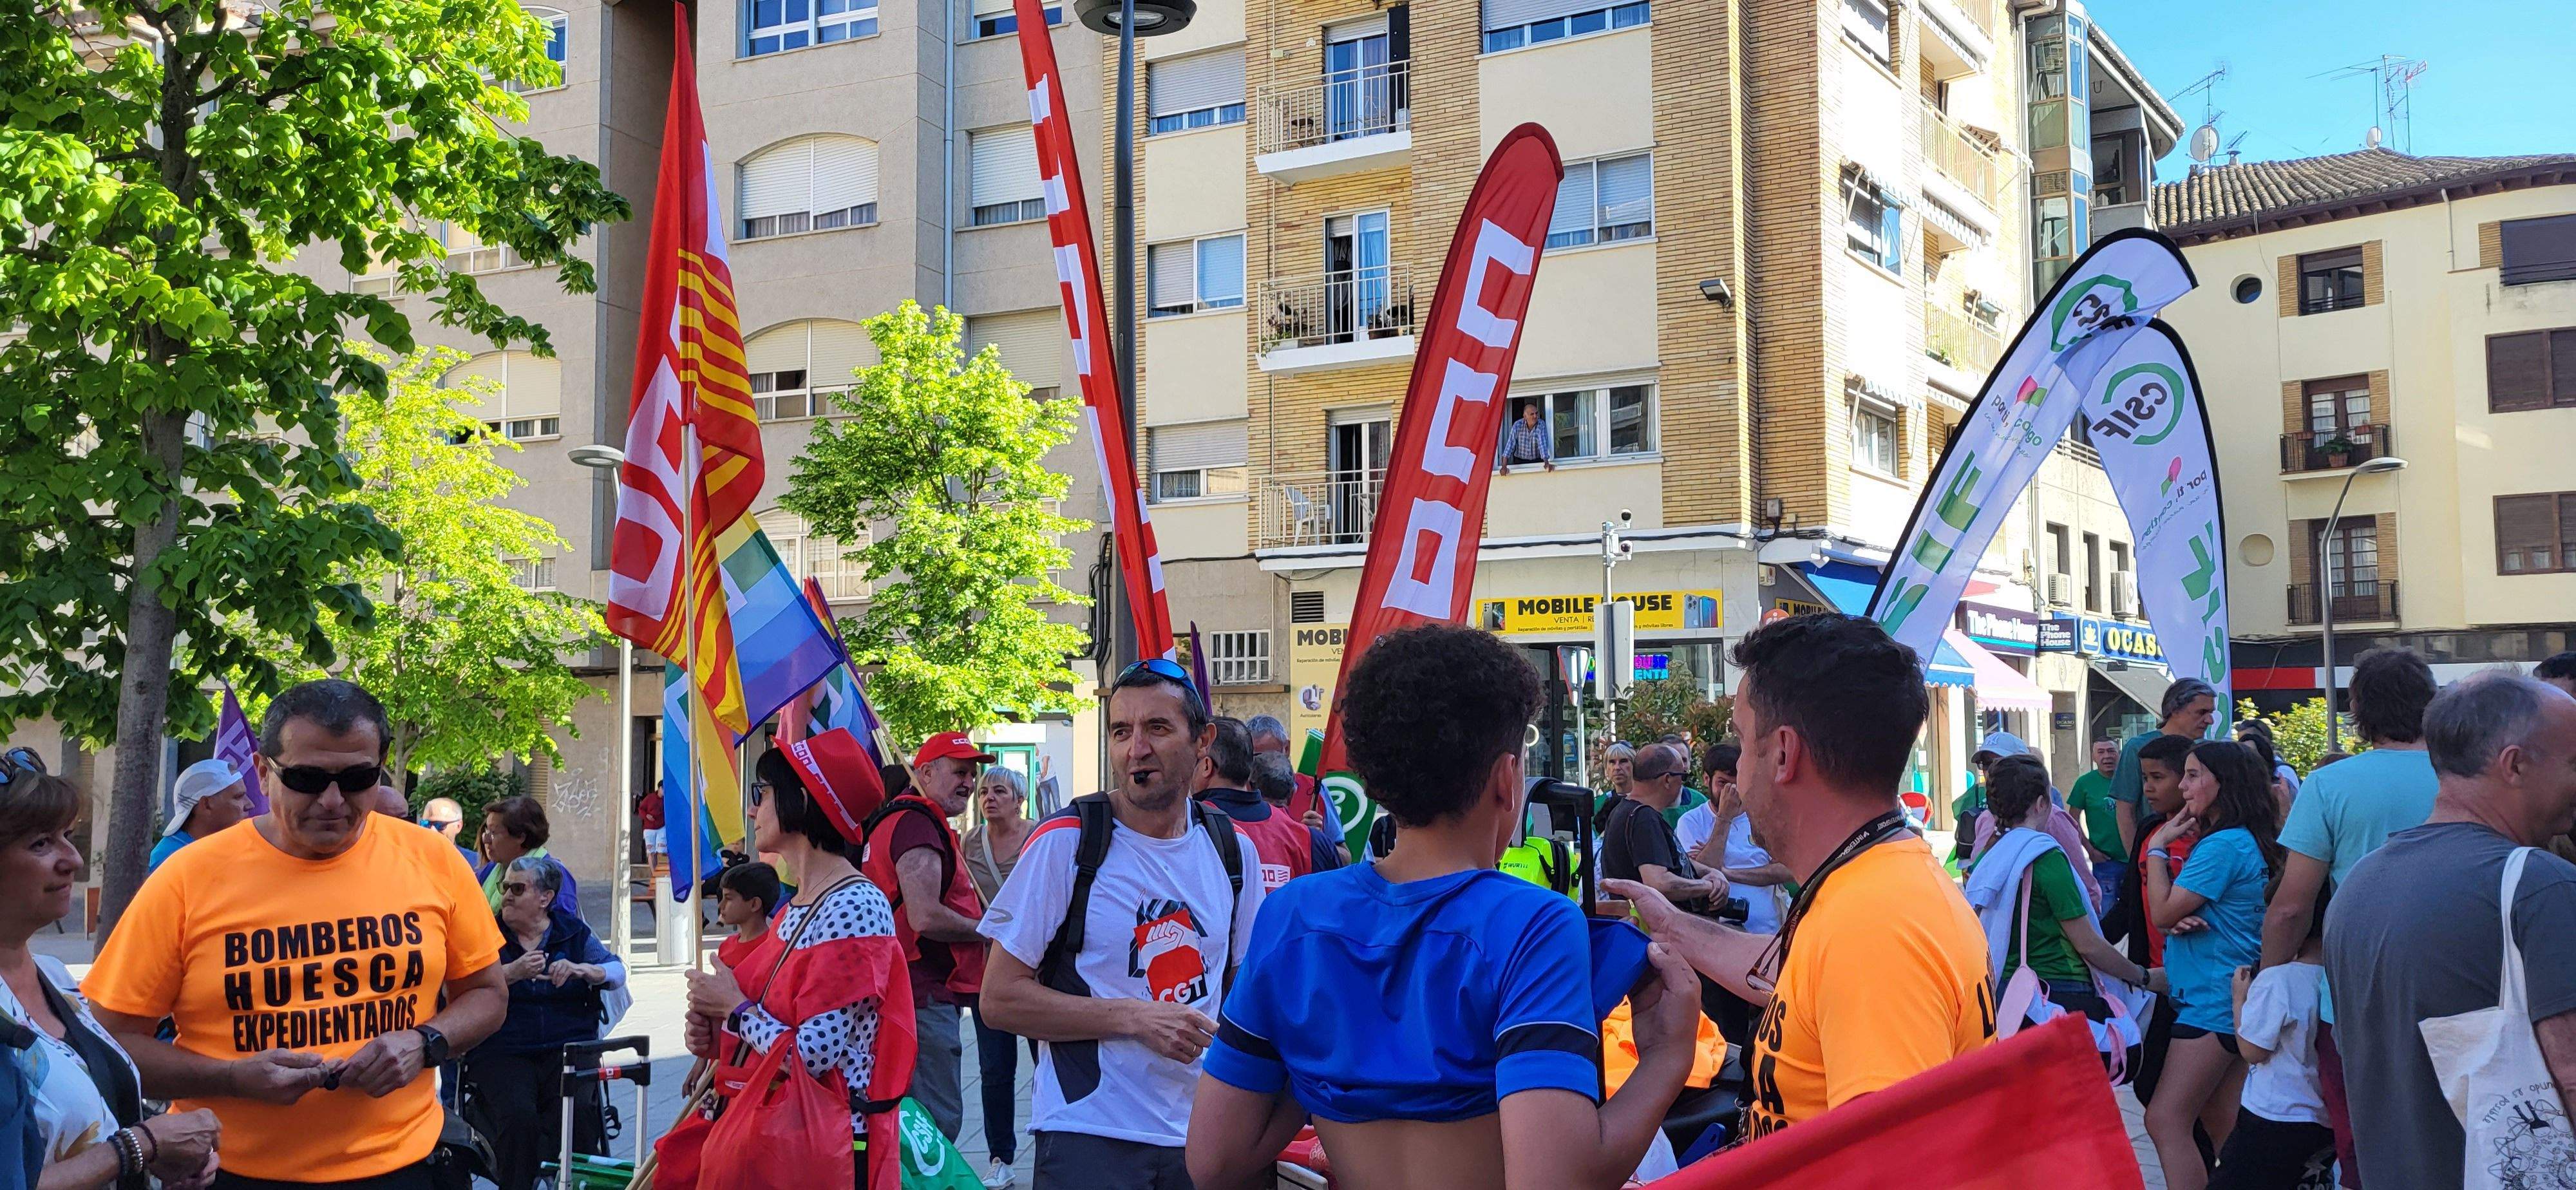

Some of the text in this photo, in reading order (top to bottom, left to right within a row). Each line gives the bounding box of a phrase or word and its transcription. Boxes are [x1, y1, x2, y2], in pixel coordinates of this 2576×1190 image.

[1518, 594, 1672, 616] MOBILE USE
[1553, 616, 1579, 624] VENTA
[2107, 627, 2163, 656] OCAS
[225, 912, 422, 968] BOMBEROS
[225, 950, 424, 1010] HUESCA
[1159, 974, 1203, 1004] CGT
[233, 994, 418, 1052] EXPEDIENTADOS
